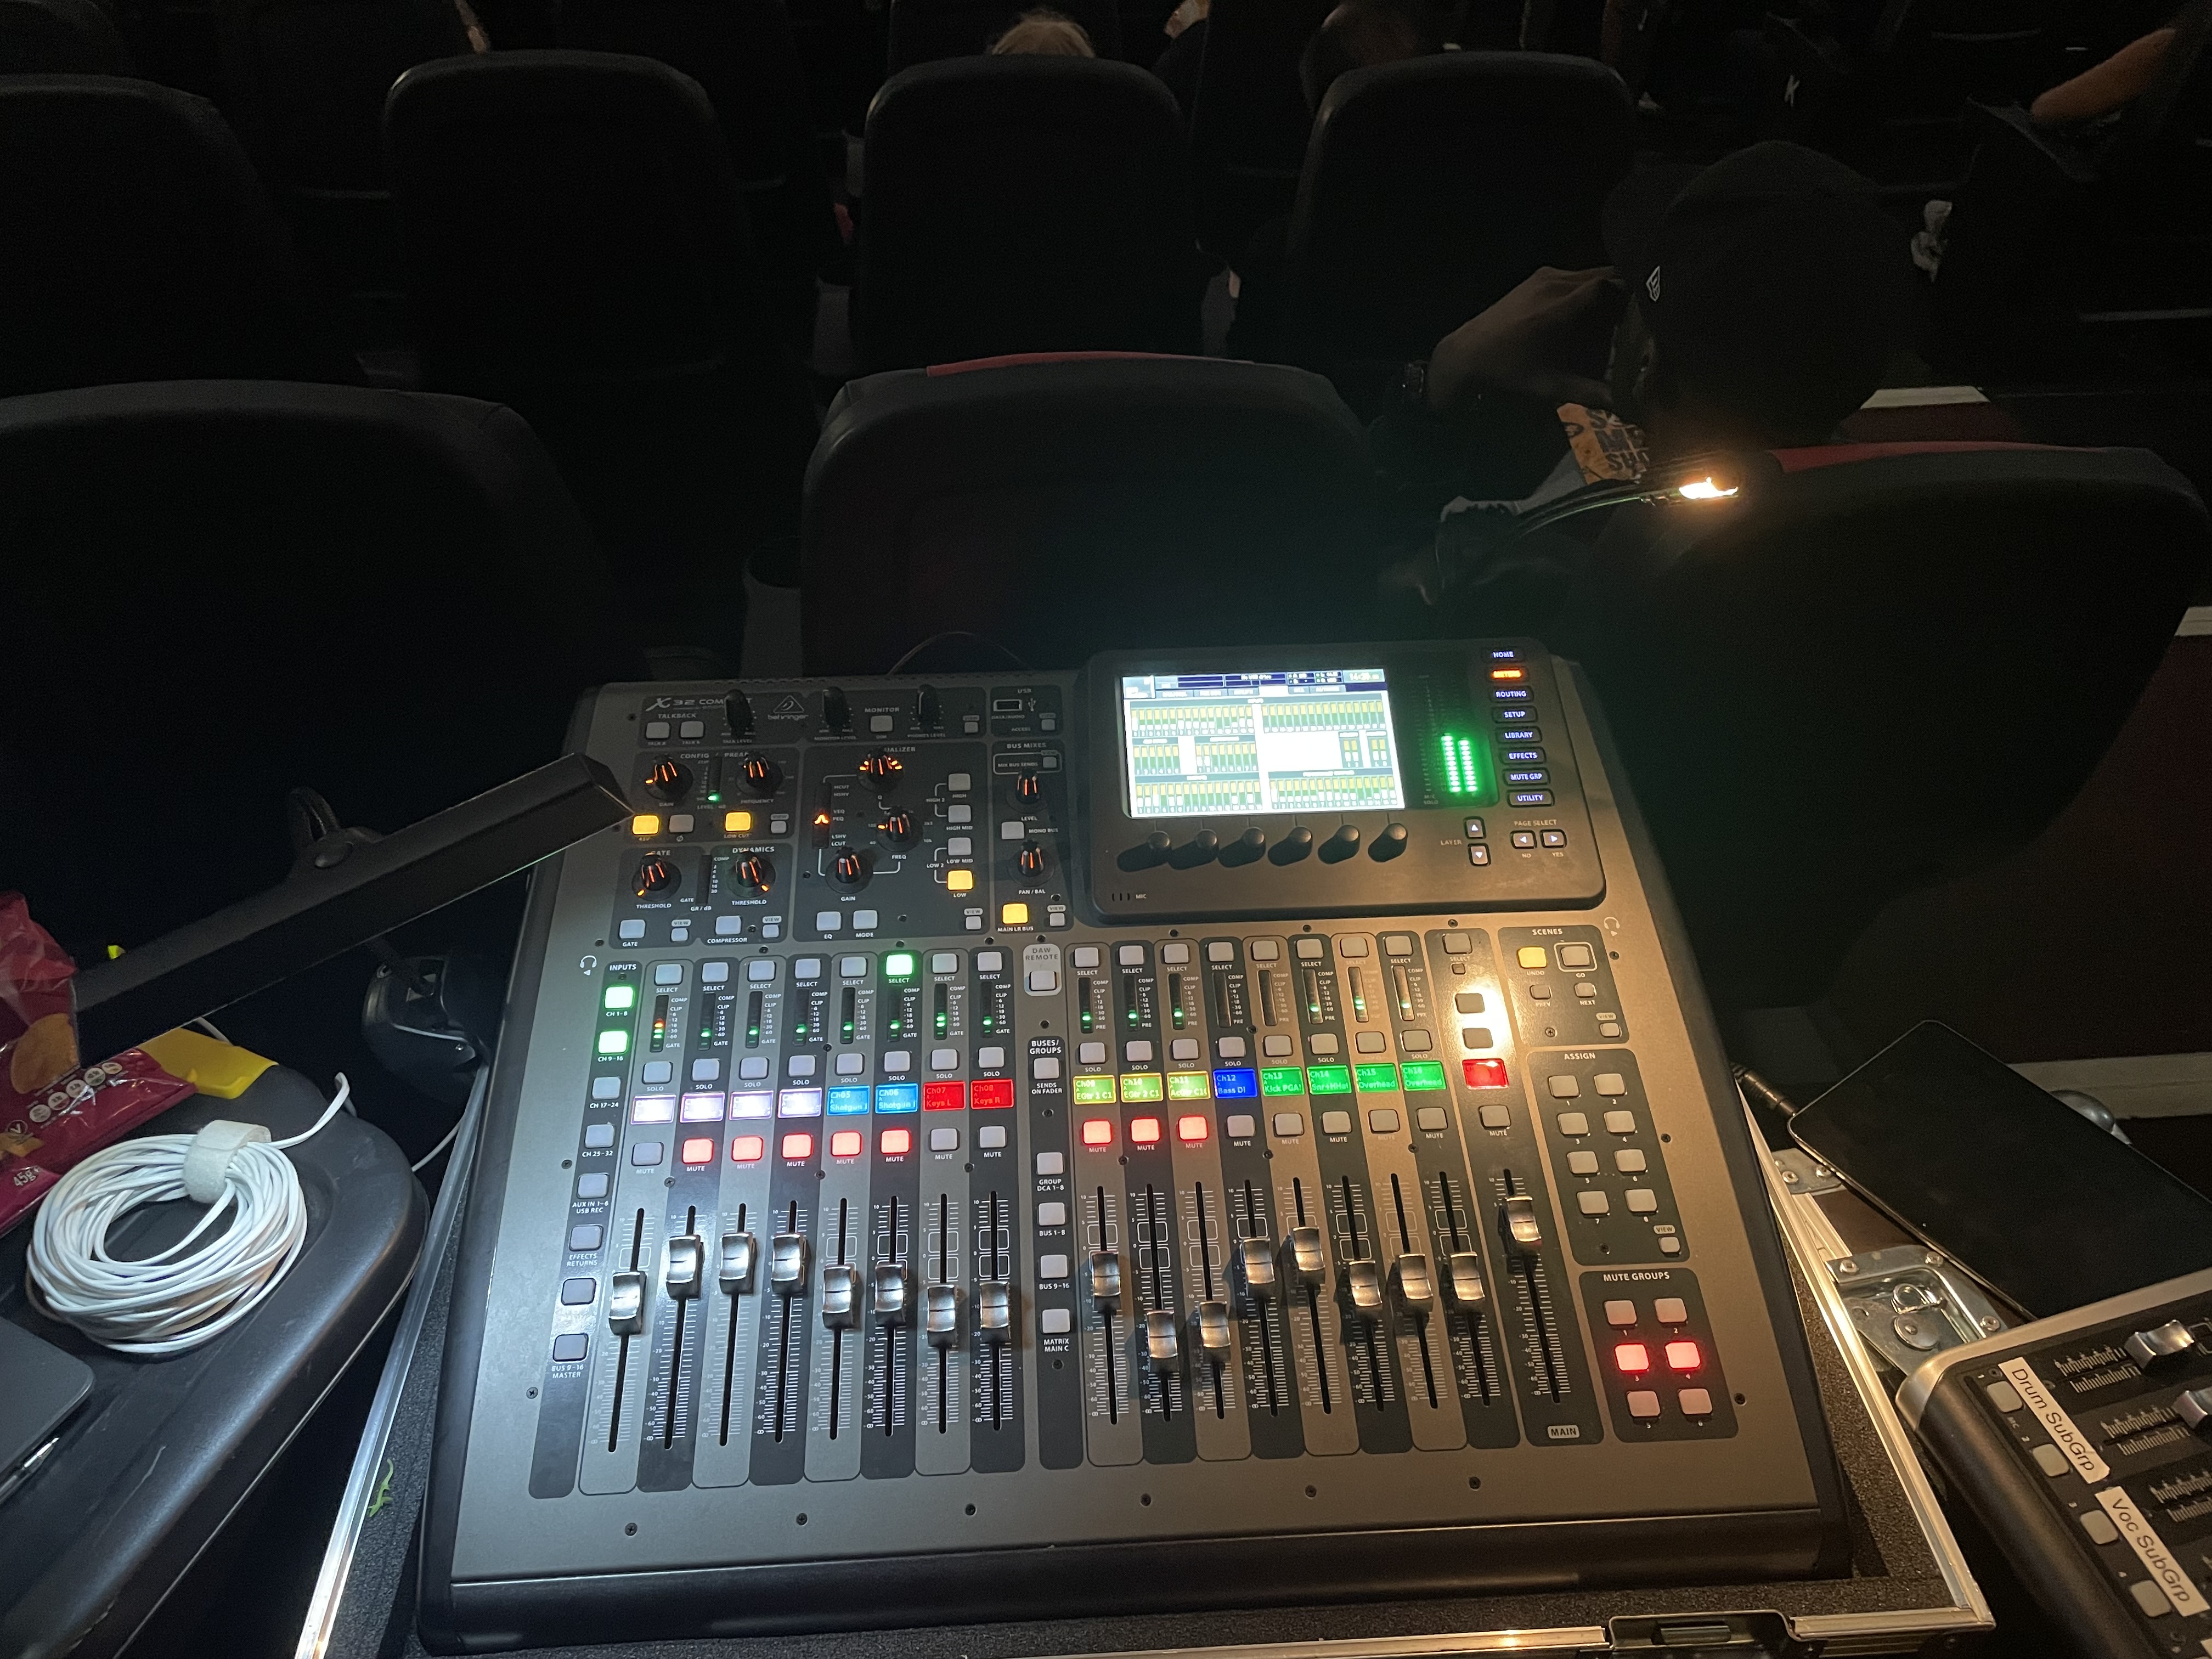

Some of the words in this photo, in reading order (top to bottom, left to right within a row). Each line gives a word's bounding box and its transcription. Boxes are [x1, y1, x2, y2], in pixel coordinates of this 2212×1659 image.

[1496, 690, 1527, 698] ROUTING
[1503, 710, 1525, 719] SETUP
[1029, 1047, 1062, 1055] GROUPS
[1564, 1052, 1596, 1060] ASSIGN
[1263, 1072, 1283, 1080] Ch13
[1310, 1070, 1329, 1079] Ch14
[1359, 1080, 1395, 1089] Overhead
[1405, 1078, 1442, 1087] Overhead
[926, 1087, 946, 1095] Ch07
[1264, 1084, 1281, 1093] Kick
[878, 1101, 911, 1110] Shotgun
[926, 1099, 945, 1108] Keys
[974, 1097, 993, 1106] Keys
[830, 1103, 862, 1112] Shotgun
[1603, 1273, 1630, 1282] MUTE
[1631, 1271, 1671, 1281] GROUPS
[2011, 1368, 2047, 1409] Drum
[2045, 1412, 2095, 1472] SubGrp
[1550, 1427, 1577, 1437] MAIN
[2112, 1498, 2140, 1533] Voc
[2136, 1533, 2191, 1603] SubGrp
